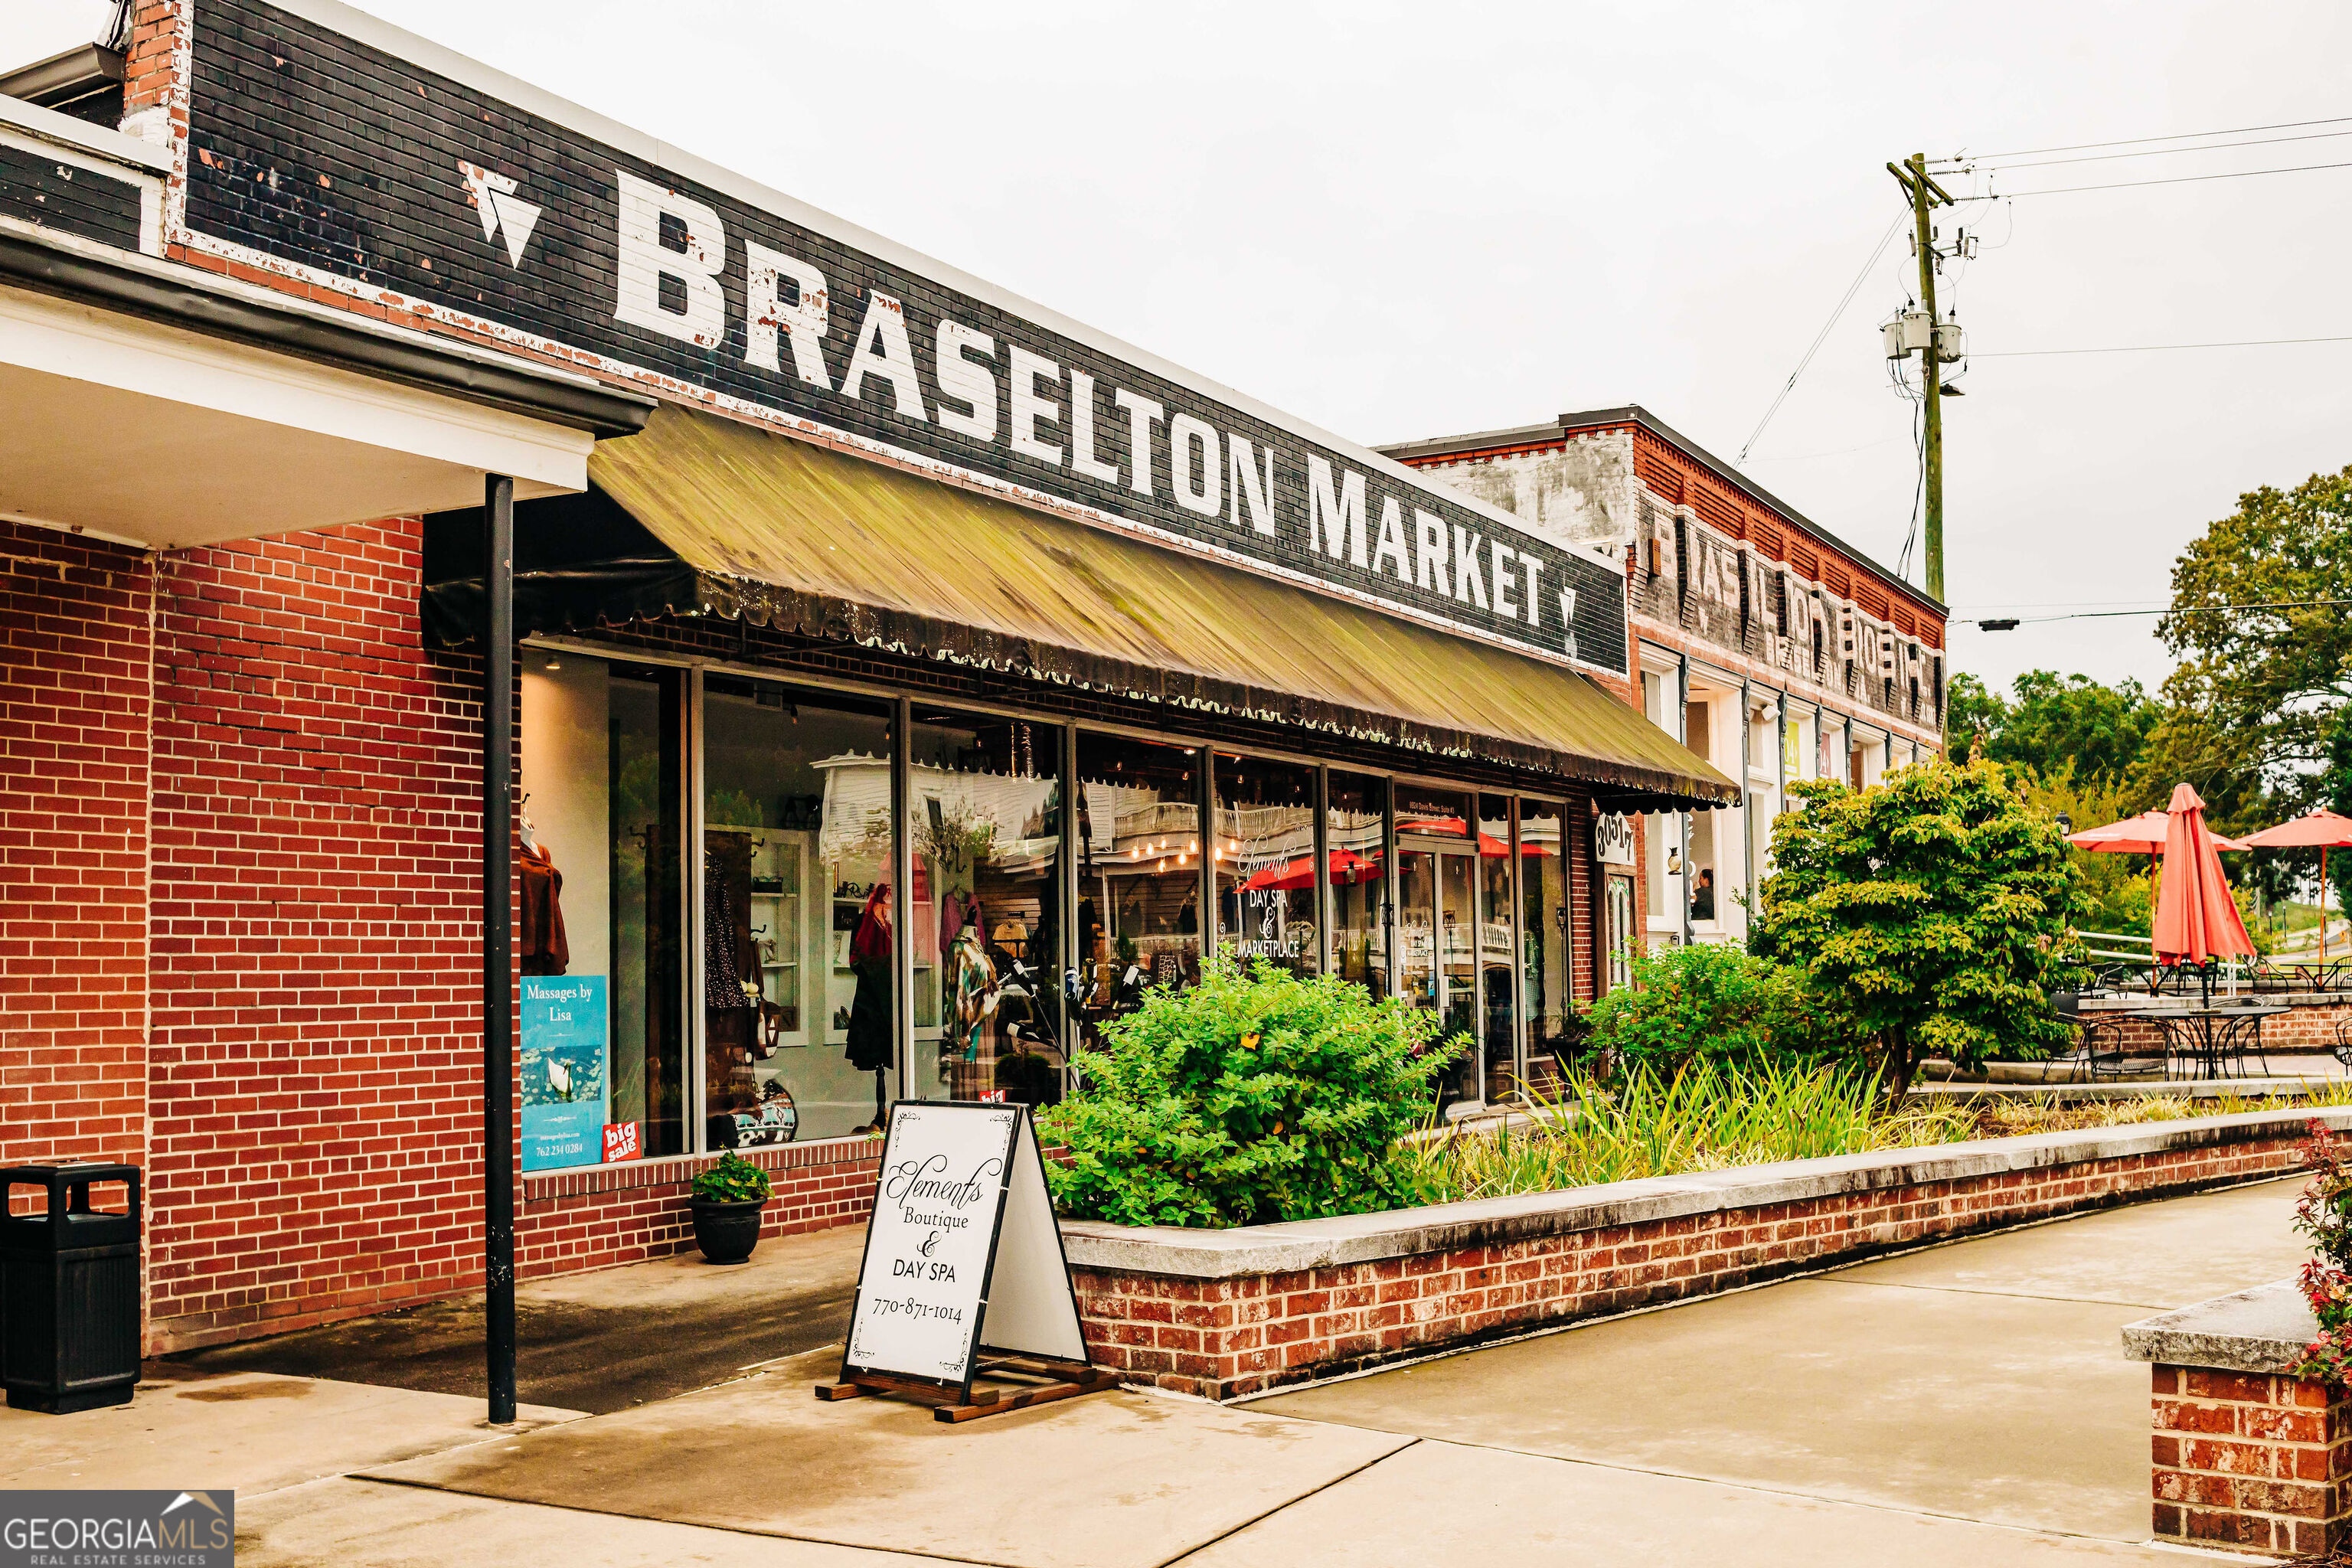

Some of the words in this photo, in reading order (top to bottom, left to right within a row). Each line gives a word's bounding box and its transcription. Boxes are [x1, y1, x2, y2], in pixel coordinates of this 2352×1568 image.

[613, 168, 1276, 537] BRASELTON
[1308, 452, 1544, 627] MARKET
[1597, 815, 1633, 861] 30517
[1237, 834, 1297, 881] Elements
[1250, 890, 1269, 908] DAY
[1271, 890, 1288, 908] SPA
[1259, 906, 1276, 939] &
[1237, 940, 1299, 959] MARKETPLACE
[527, 985, 577, 1003] Massages
[580, 984, 593, 1002] by
[549, 1007, 572, 1022] Lisa
[605, 1121, 637, 1148] big
[536, 1146, 550, 1157] 762
[551, 1145, 564, 1156] 234
[565, 1143, 583, 1155] 0284
[608, 1140, 637, 1163] sale
[886, 1154, 1003, 1210] Elements
[903, 1206, 969, 1233] Boutique
[916, 1230, 942, 1258] &
[893, 1259, 926, 1279] DAY
[929, 1263, 956, 1283] SPA
[872, 1298, 962, 1325] 770-871-1014
